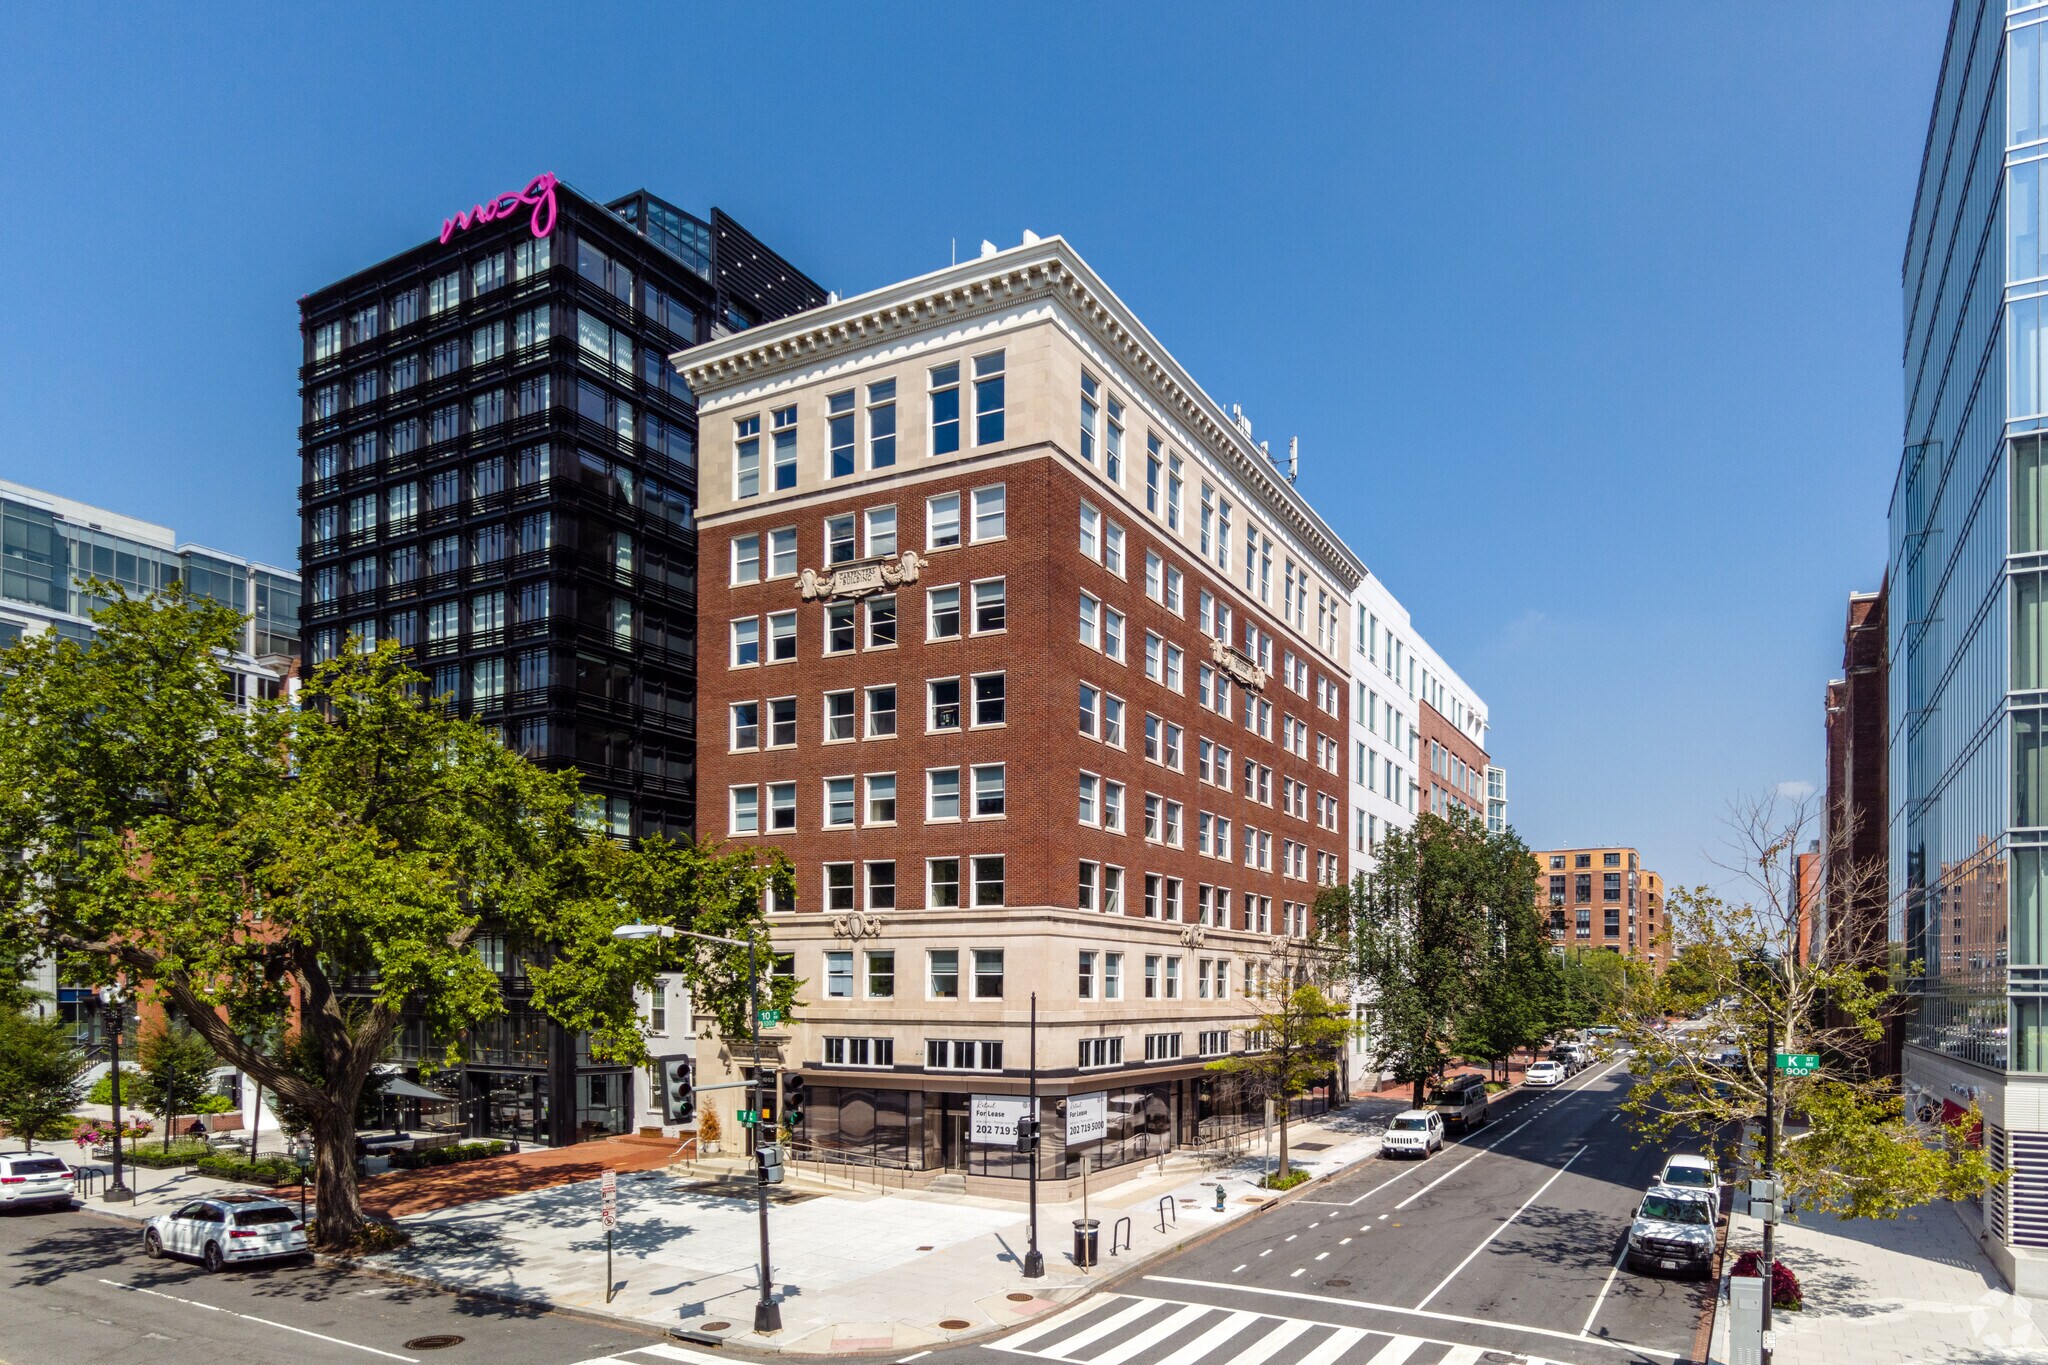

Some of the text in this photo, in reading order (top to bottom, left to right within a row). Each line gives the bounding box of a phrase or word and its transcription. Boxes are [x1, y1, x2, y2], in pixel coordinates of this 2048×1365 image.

[440, 171, 557, 244] moxy
[838, 568, 875, 580] CARPENTERS
[842, 575, 872, 585] BUILDING
[761, 1011, 771, 1020] 10
[1788, 1056, 1798, 1067] K
[1786, 1067, 1808, 1076] 900
[976, 1125, 992, 1134] 202
[995, 1126, 1010, 1135] 719
[1069, 1125, 1080, 1136] 202
[1081, 1123, 1091, 1133] 719
[1091, 1120, 1105, 1131] 5000
